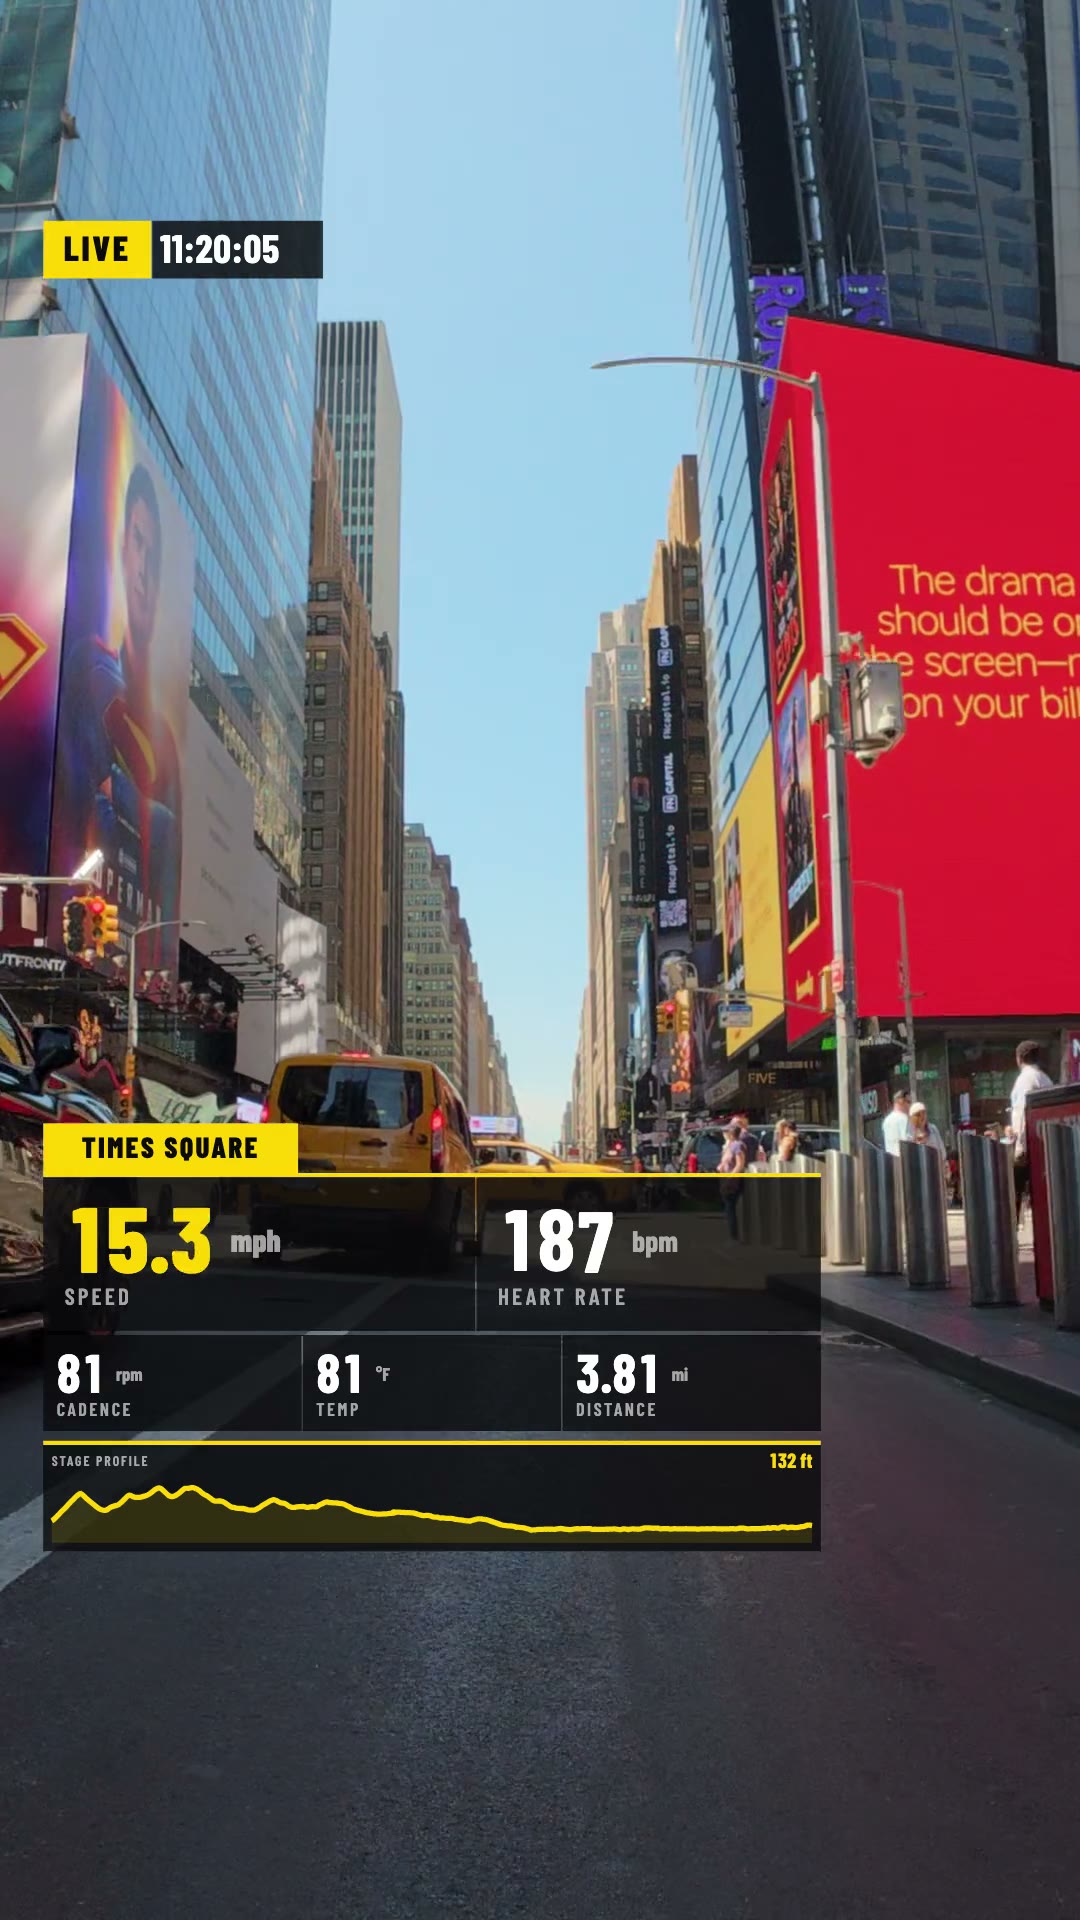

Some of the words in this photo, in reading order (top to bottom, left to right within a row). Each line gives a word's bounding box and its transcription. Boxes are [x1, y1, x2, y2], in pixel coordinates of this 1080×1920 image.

[889, 563, 956, 596] The
[965, 564, 1076, 598] drama
[877, 603, 990, 637] should
[999, 604, 1044, 637] be
[953, 693, 1030, 727] your
[664, 752, 675, 794] CAPITAL
[748, 1072, 777, 1084] FIVE
